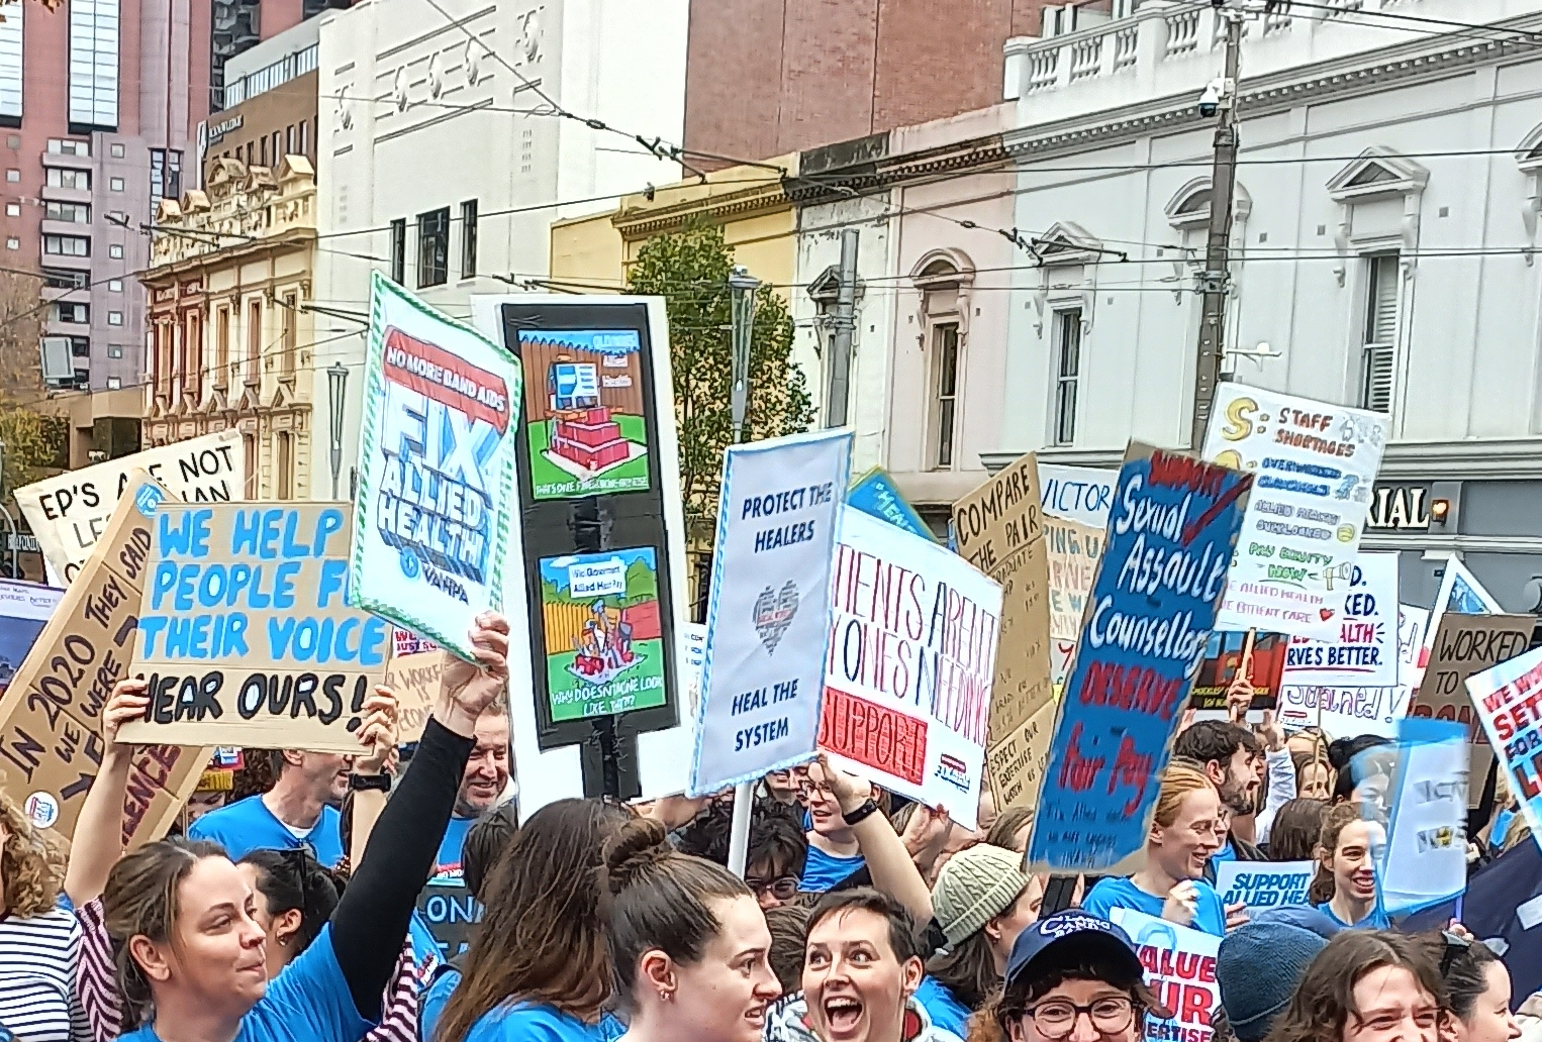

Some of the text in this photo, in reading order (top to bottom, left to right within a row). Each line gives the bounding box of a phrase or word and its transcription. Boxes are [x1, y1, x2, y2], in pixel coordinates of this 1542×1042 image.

[386, 345, 505, 412] NO MORE BAND AIDS
[1278, 407, 1334, 432] STAFF
[1274, 429, 1356, 458] SHORTAGES
[38, 445, 233, 521] EP'S NOT
[380, 454, 488, 530] ALLIED
[741, 481, 833, 521] PROTECT THE
[957, 464, 1030, 547] COMPARE
[1005, 504, 1039, 547] PAIR
[1116, 473, 1192, 543] Sexual
[159, 508, 344, 560] WE HELP
[377, 493, 489, 570] HEALTH
[754, 520, 816, 554] HEALERS
[1249, 541, 1276, 559] PAY
[151, 559, 302, 611] PEOPLE
[421, 564, 470, 606] VAHPA
[1116, 532, 1227, 603] Assault
[1268, 564, 1309, 582] NOW
[1239, 582, 1278, 596] ALLIED
[28, 634, 96, 732] 2020
[85, 574, 128, 629] THEY
[119, 527, 152, 581] SAID
[1282, 606, 1312, 624] CARE
[137, 611, 387, 665] THEIR VOICE
[843, 617, 912, 700] ONES
[1327, 646, 1383, 666] BETTER.
[237, 672, 368, 733] OURS!
[731, 678, 800, 716] HEAL THE
[1079, 660, 1182, 721] DESERVE
[1435, 671, 1459, 695] TO
[1482, 684, 1509, 714] WE
[54, 649, 122, 764] WE WERE
[734, 716, 790, 752] SYSTEM
[818, 687, 927, 780] SUPPORT
[1024, 721, 1040, 744] OUR
[1504, 728, 1542, 764] FOR
[1107, 735, 1153, 817] Pay
[1223, 890, 1280, 907] ALLIED
[1232, 873, 1311, 891] SUPPORT
